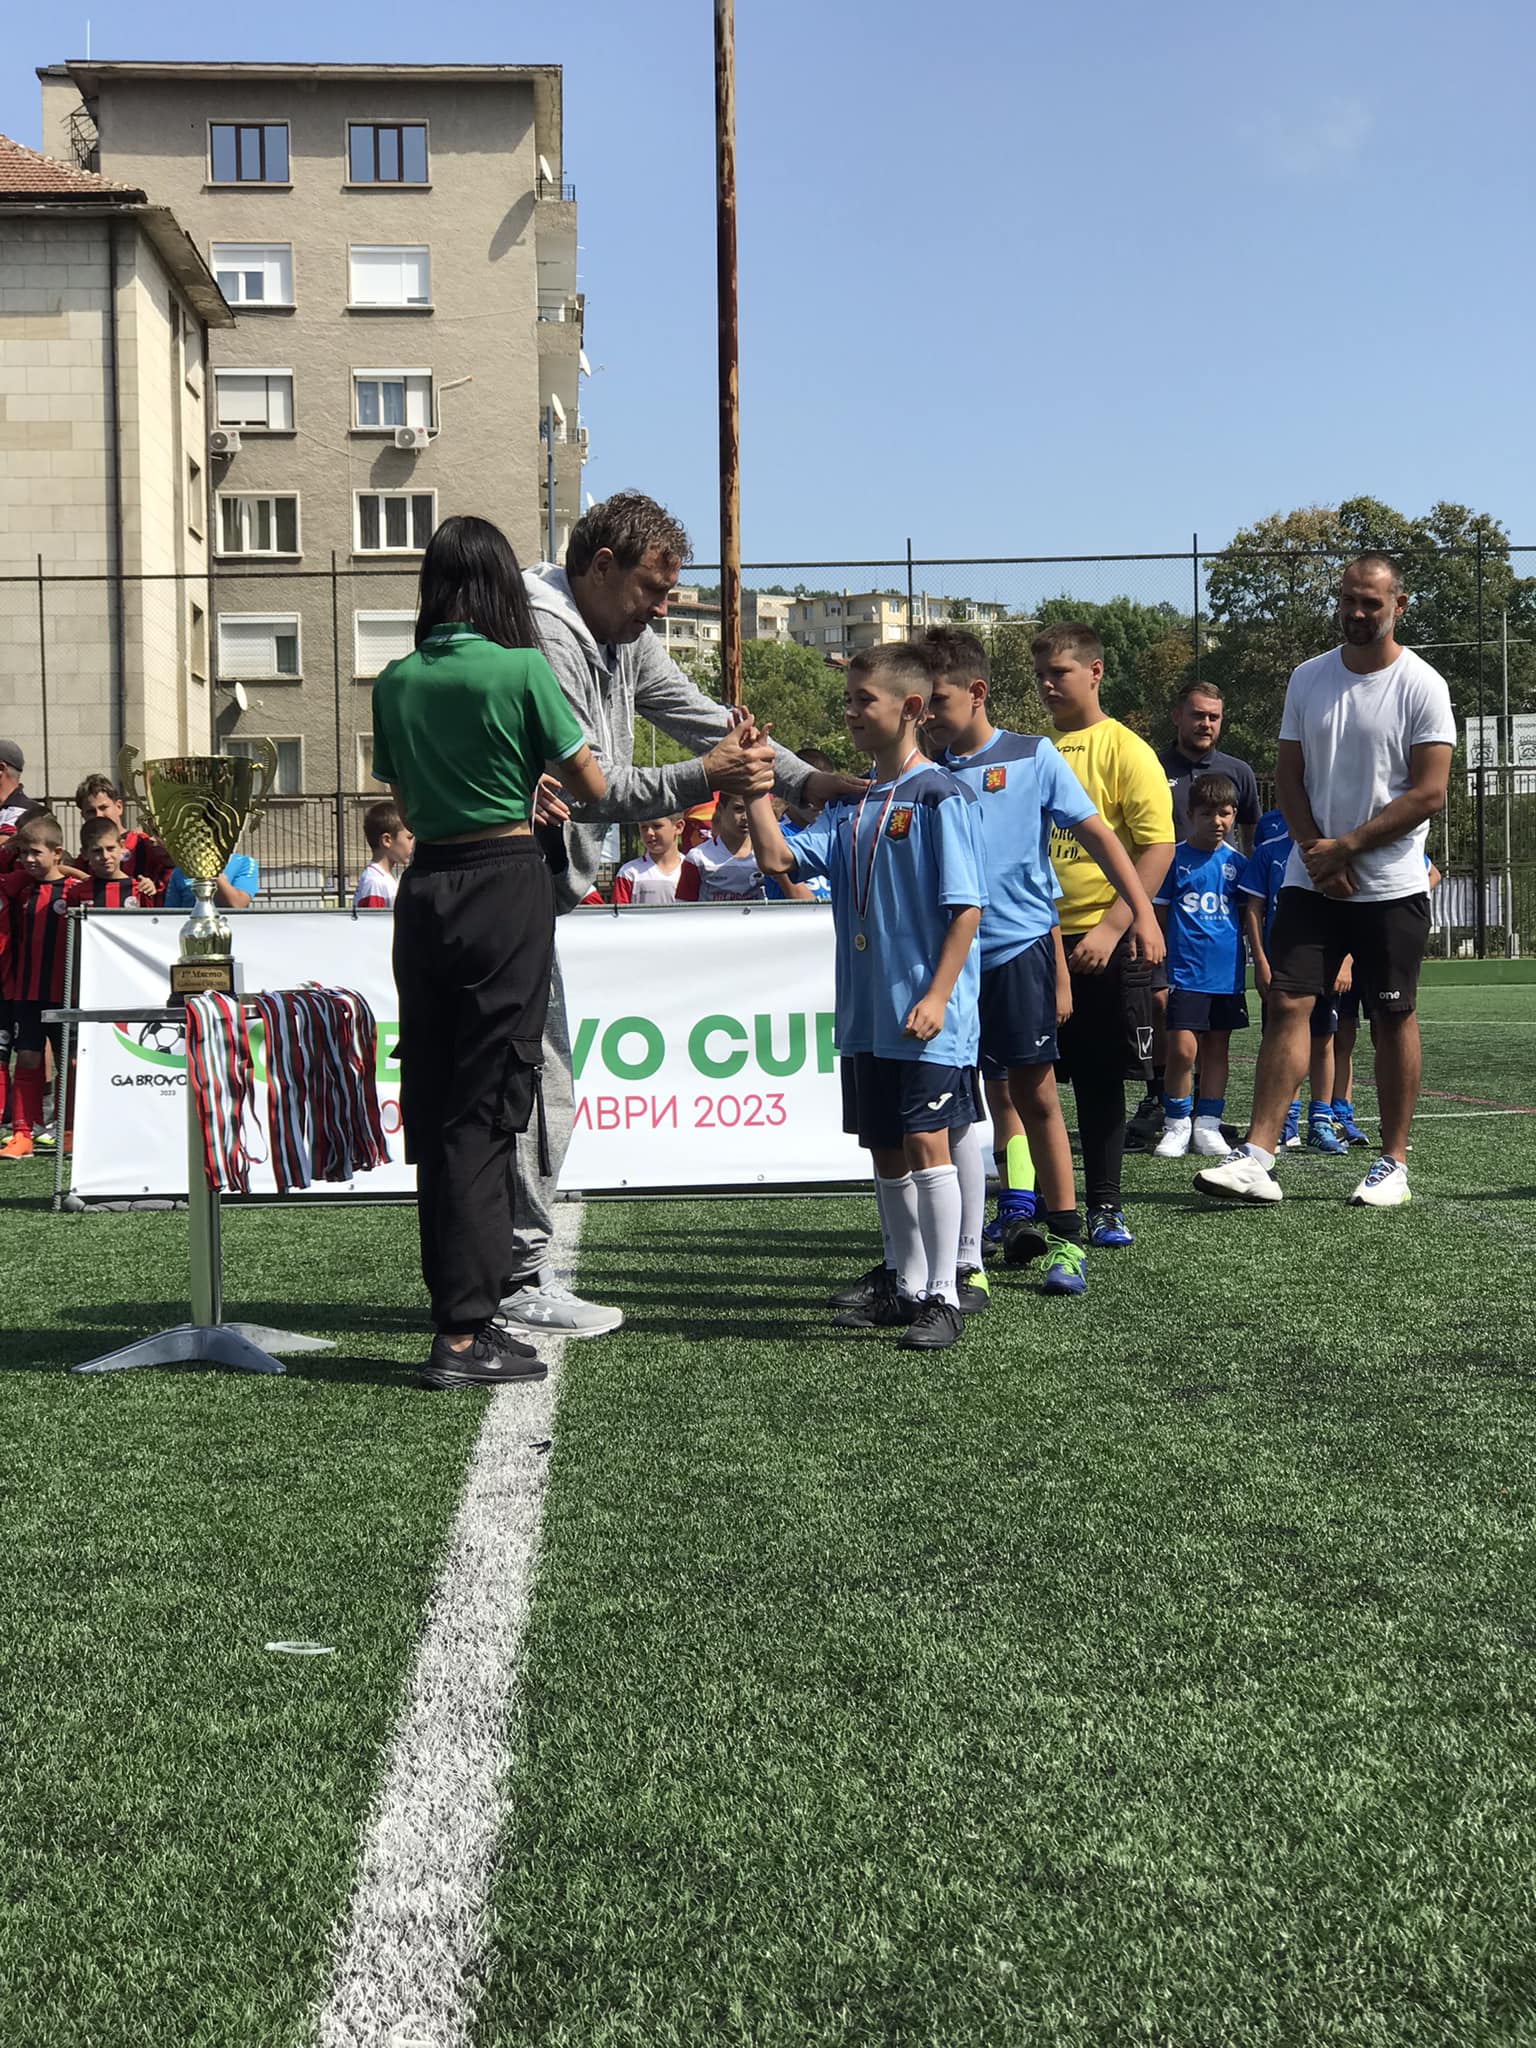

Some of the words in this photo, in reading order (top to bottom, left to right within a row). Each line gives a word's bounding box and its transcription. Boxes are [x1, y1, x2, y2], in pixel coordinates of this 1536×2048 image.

[1182, 891, 1230, 915] SOS
[1379, 990, 1401, 1000] one
[694, 1093, 787, 1128] 2023
